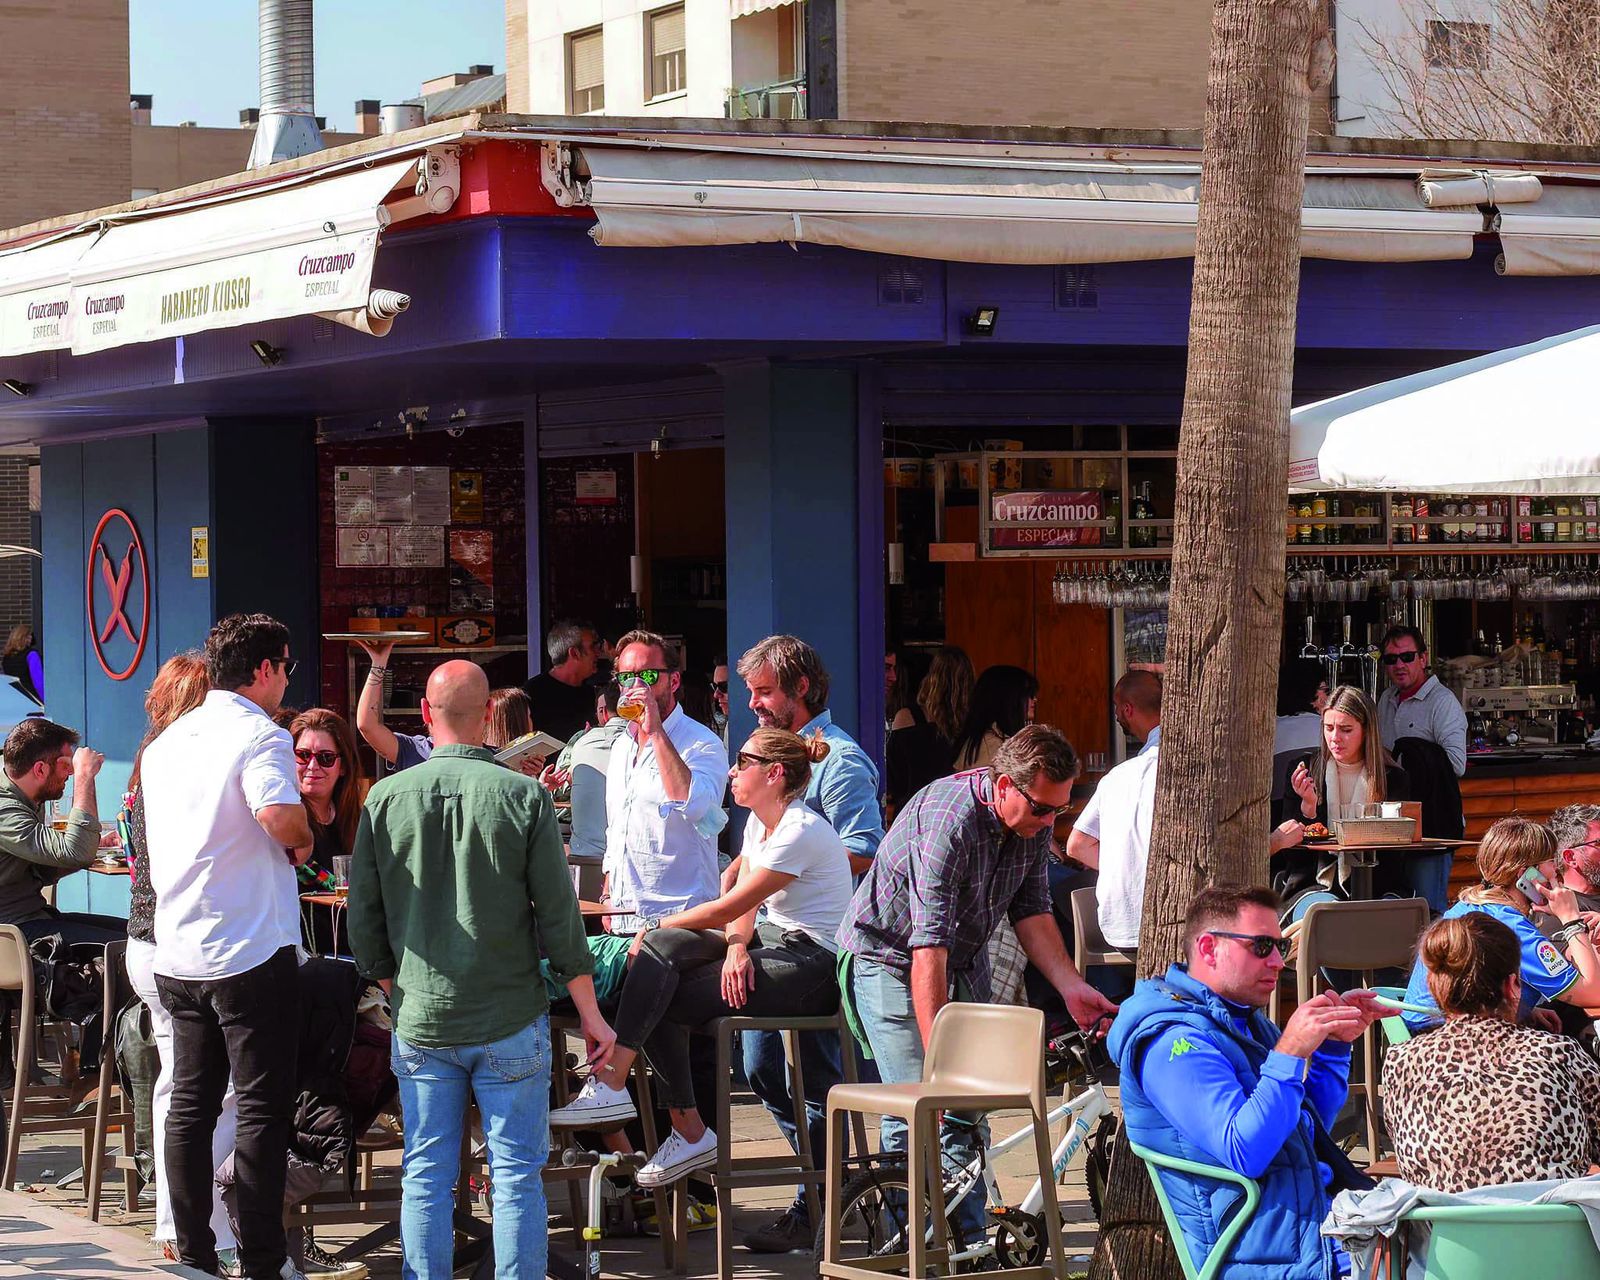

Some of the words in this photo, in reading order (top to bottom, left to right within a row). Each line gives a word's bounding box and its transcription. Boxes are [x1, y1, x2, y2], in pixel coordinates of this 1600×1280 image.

[298, 252, 355, 276] Cruzcampo
[304, 280, 340, 297] ESPECIAL
[27, 300, 69, 320] Cruzcampo
[85, 294, 125, 316] Cruzcampo
[161, 284, 210, 325] HABANERO
[212, 277, 250, 312] KIOSCO
[32, 323, 60, 339] ESPECIAL
[92, 319, 117, 335] ESPECIAL
[995, 499, 1098, 521] Cruzcampo
[1017, 528, 1077, 542] ESPECIAL
